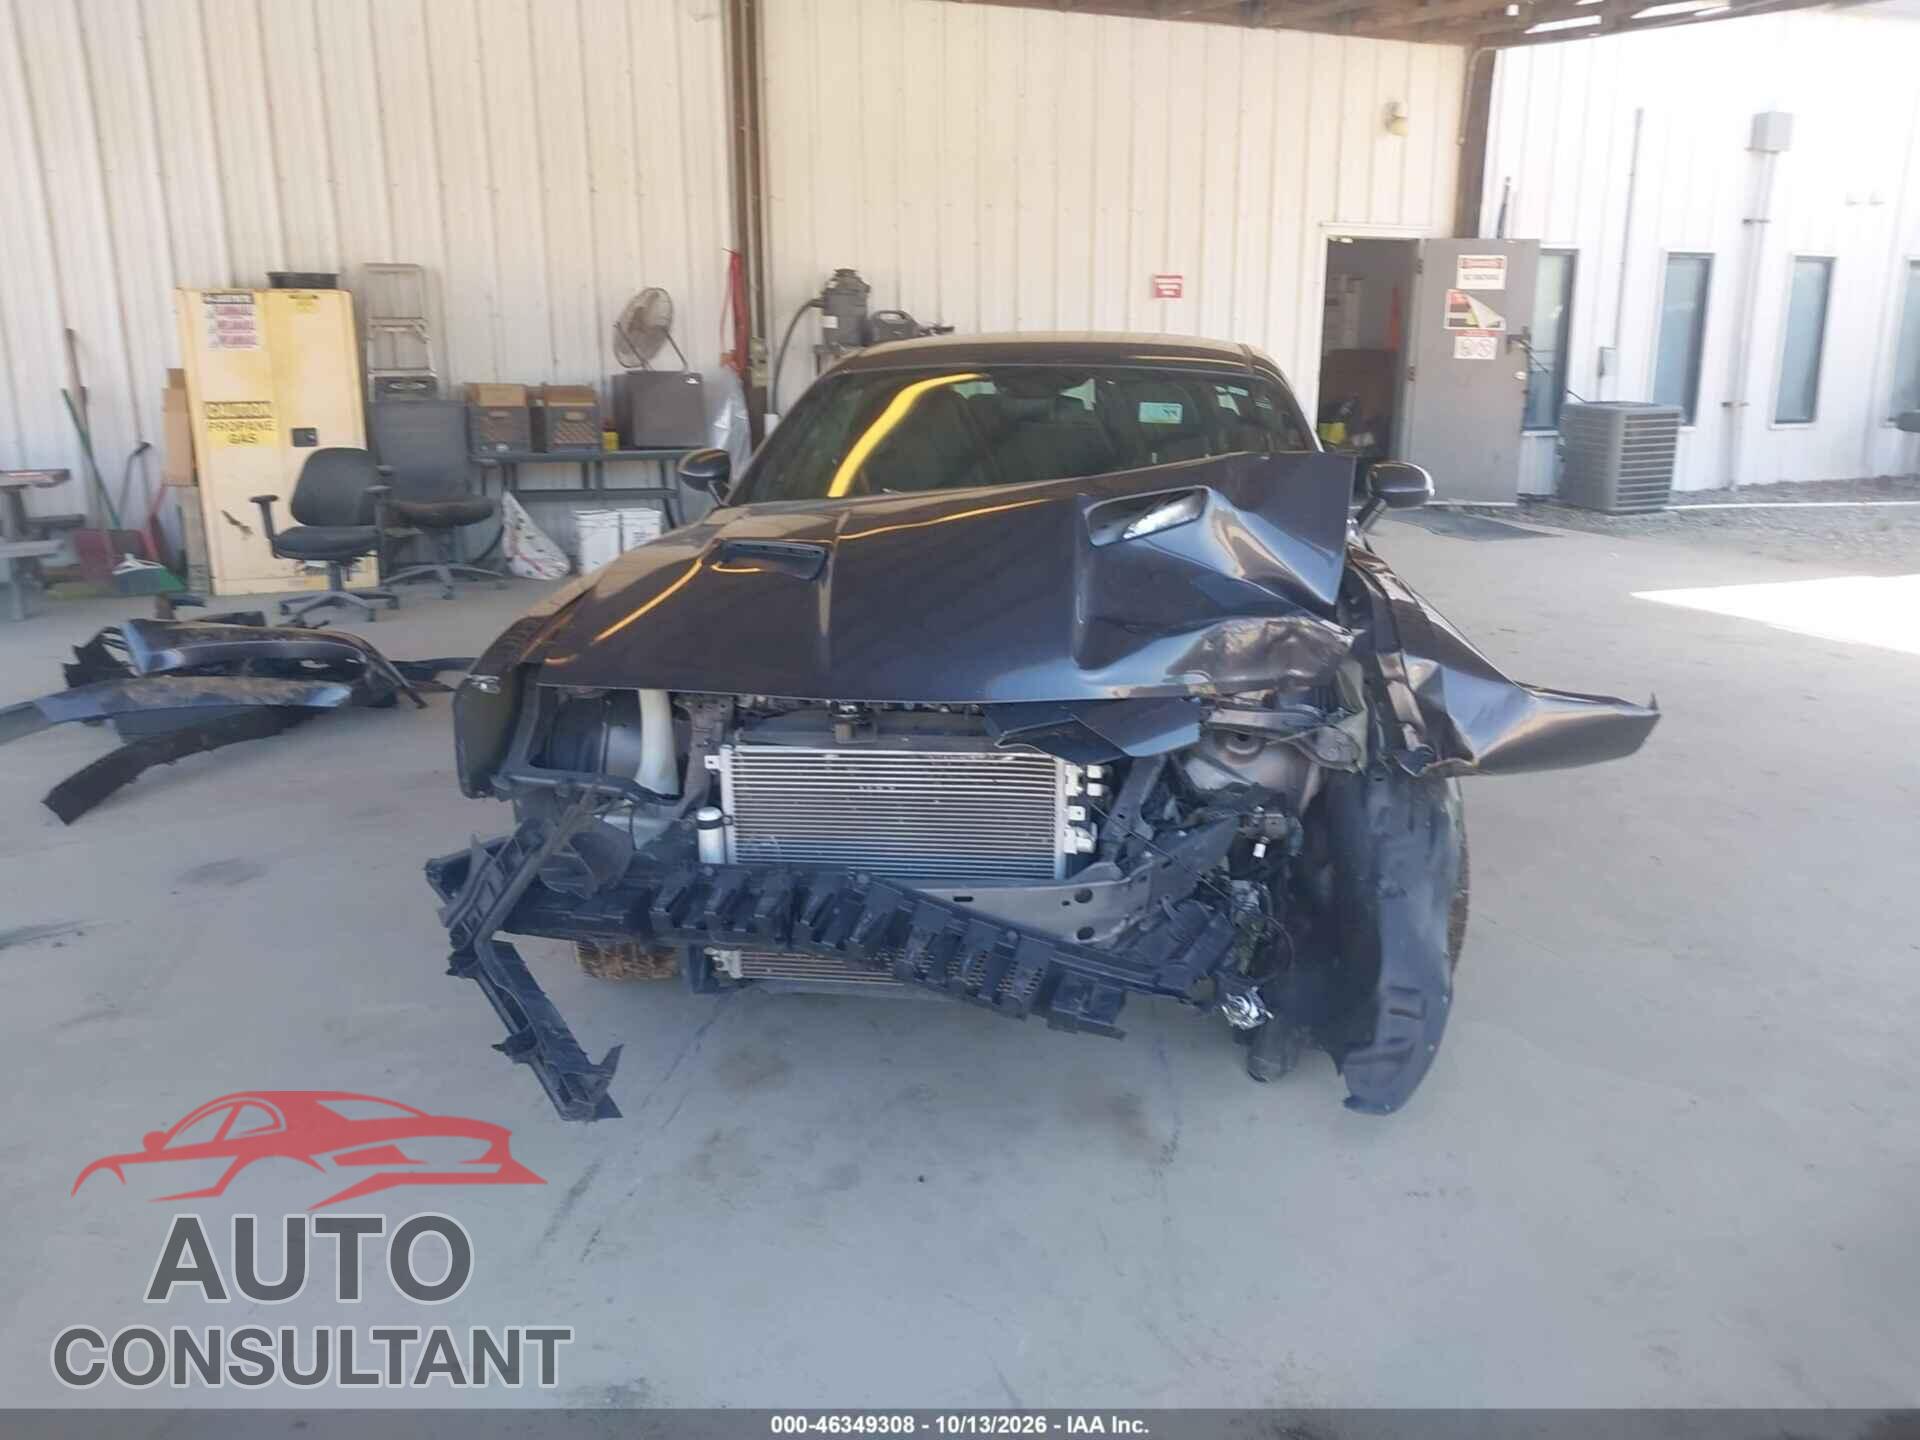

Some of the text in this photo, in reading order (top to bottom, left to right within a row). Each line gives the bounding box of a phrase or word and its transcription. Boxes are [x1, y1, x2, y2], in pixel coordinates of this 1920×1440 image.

[206, 402, 271, 419] CAUTION
[207, 420, 277, 432] PROPANE
[227, 432, 257, 444] GAS
